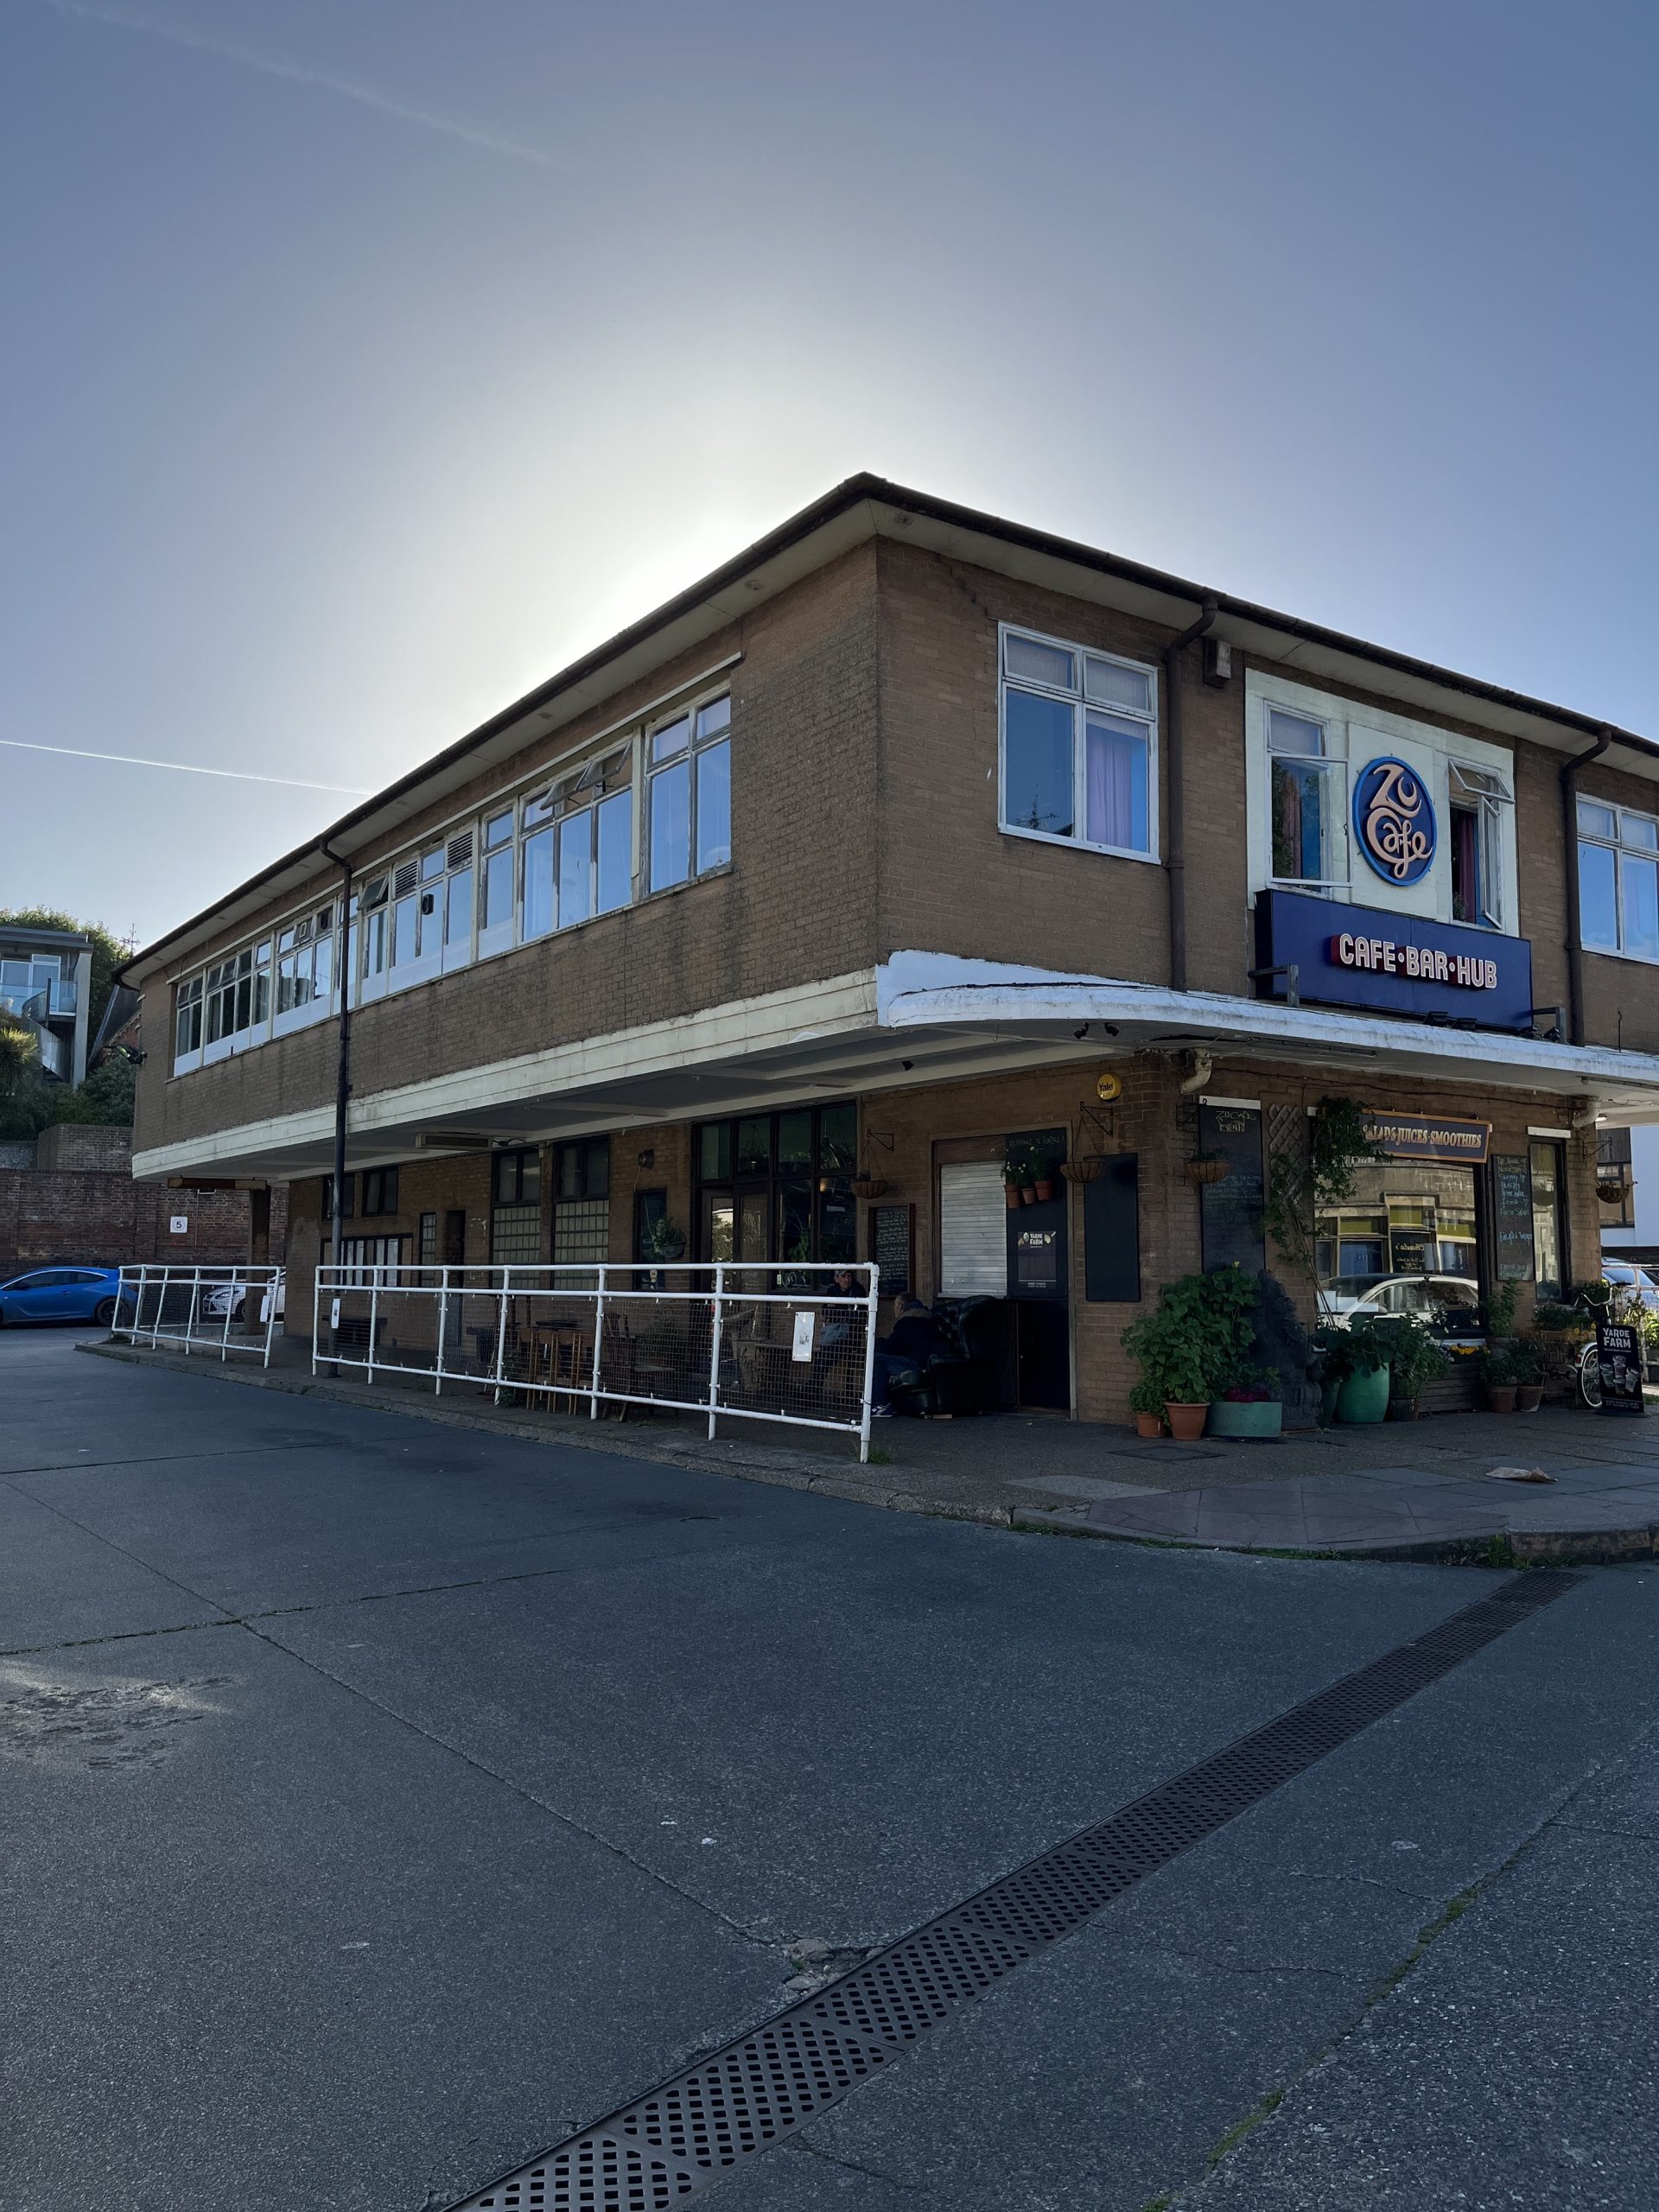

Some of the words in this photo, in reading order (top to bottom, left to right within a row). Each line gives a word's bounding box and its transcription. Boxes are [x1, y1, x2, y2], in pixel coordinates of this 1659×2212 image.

[1098, 1082, 1114, 1092] Yale
[175, 1220, 182, 1229] 5
[1603, 1327, 1630, 1338] YARDE
[1604, 1337, 1631, 1348] FARM
